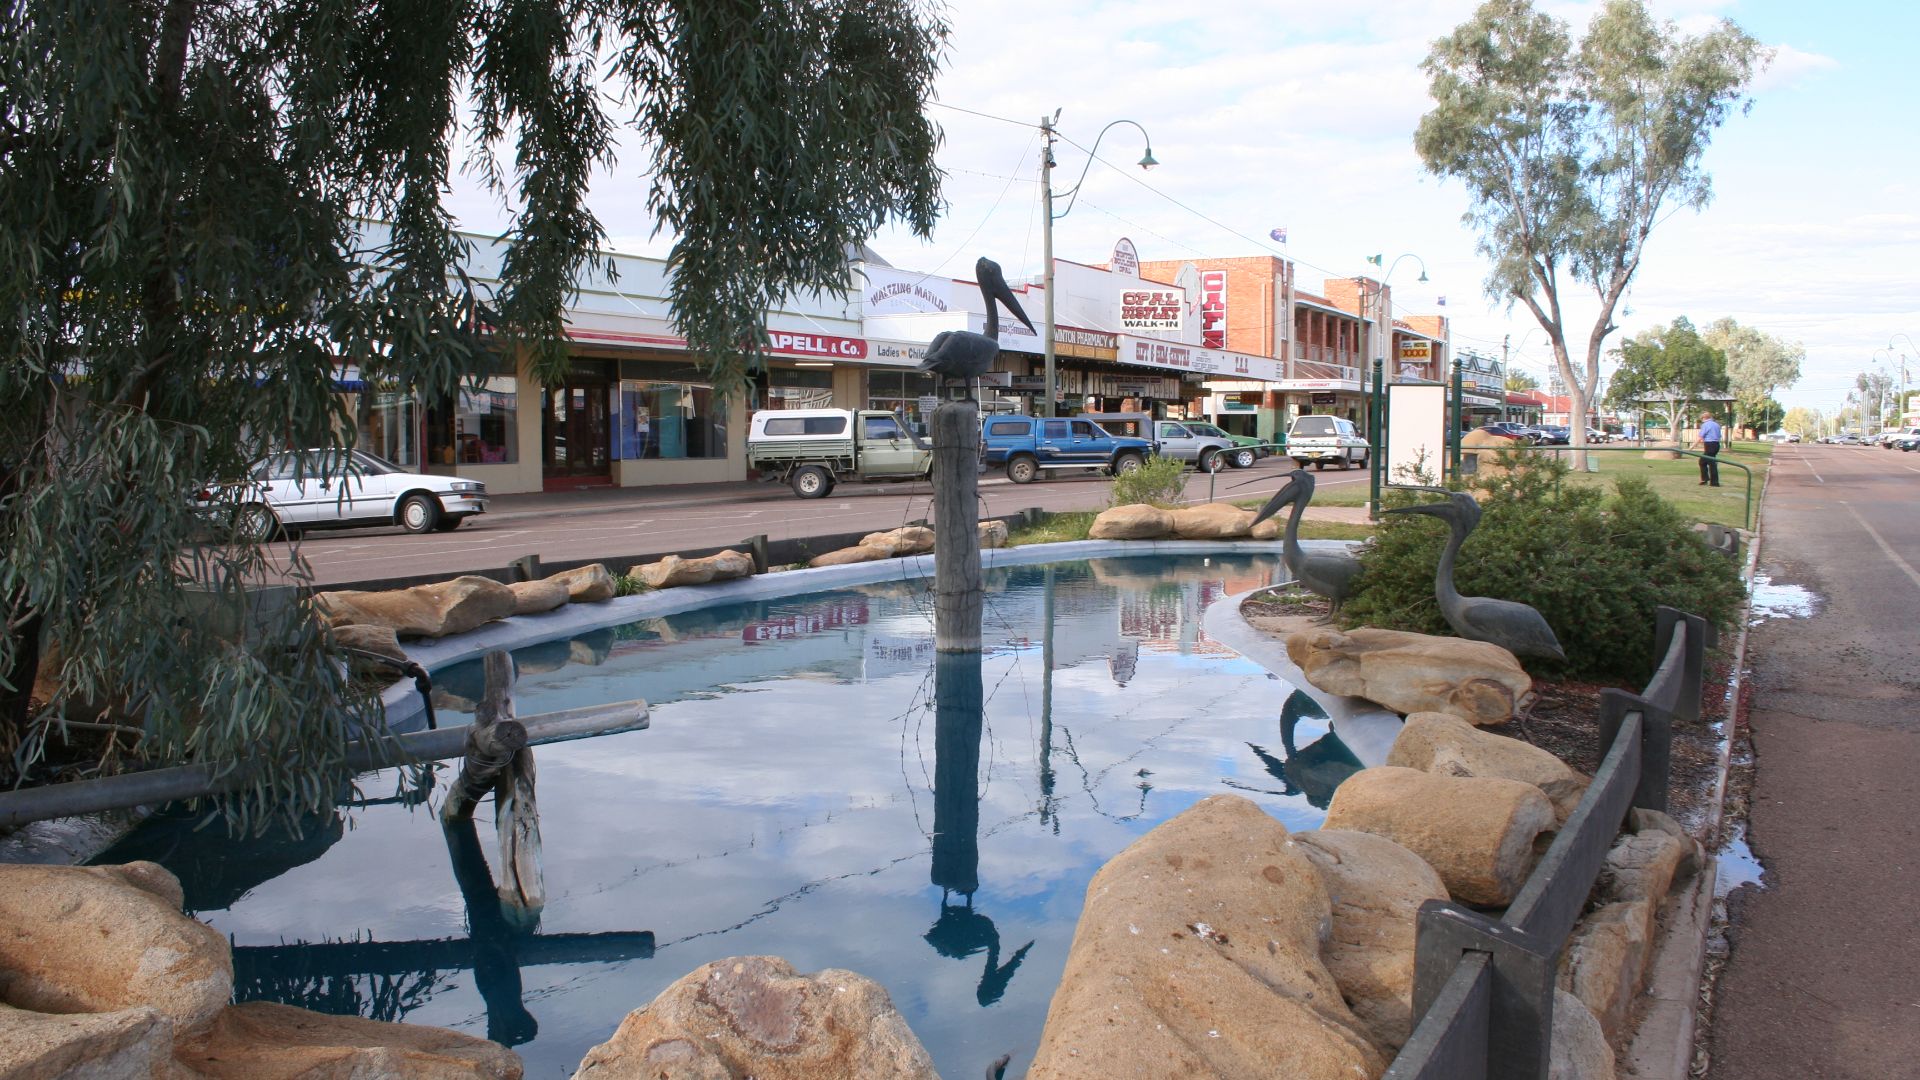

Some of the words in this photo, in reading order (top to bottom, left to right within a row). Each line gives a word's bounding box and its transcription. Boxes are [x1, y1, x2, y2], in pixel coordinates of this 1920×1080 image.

[871, 283, 910, 306] WALTZING
[914, 285, 948, 312] MATILDA
[1123, 292, 1180, 306] OPAL
[1122, 306, 1181, 320] DISPLAY
[1124, 320, 1178, 328] WALK-IN
[767, 333, 827, 353] APELL
[831, 343, 838, 353] &
[840, 341, 860, 355] Co.
[1077, 331, 1108, 348] PHARMACY
[877, 345, 900, 357] Ladies
[1403, 349, 1427, 357] XXXX
